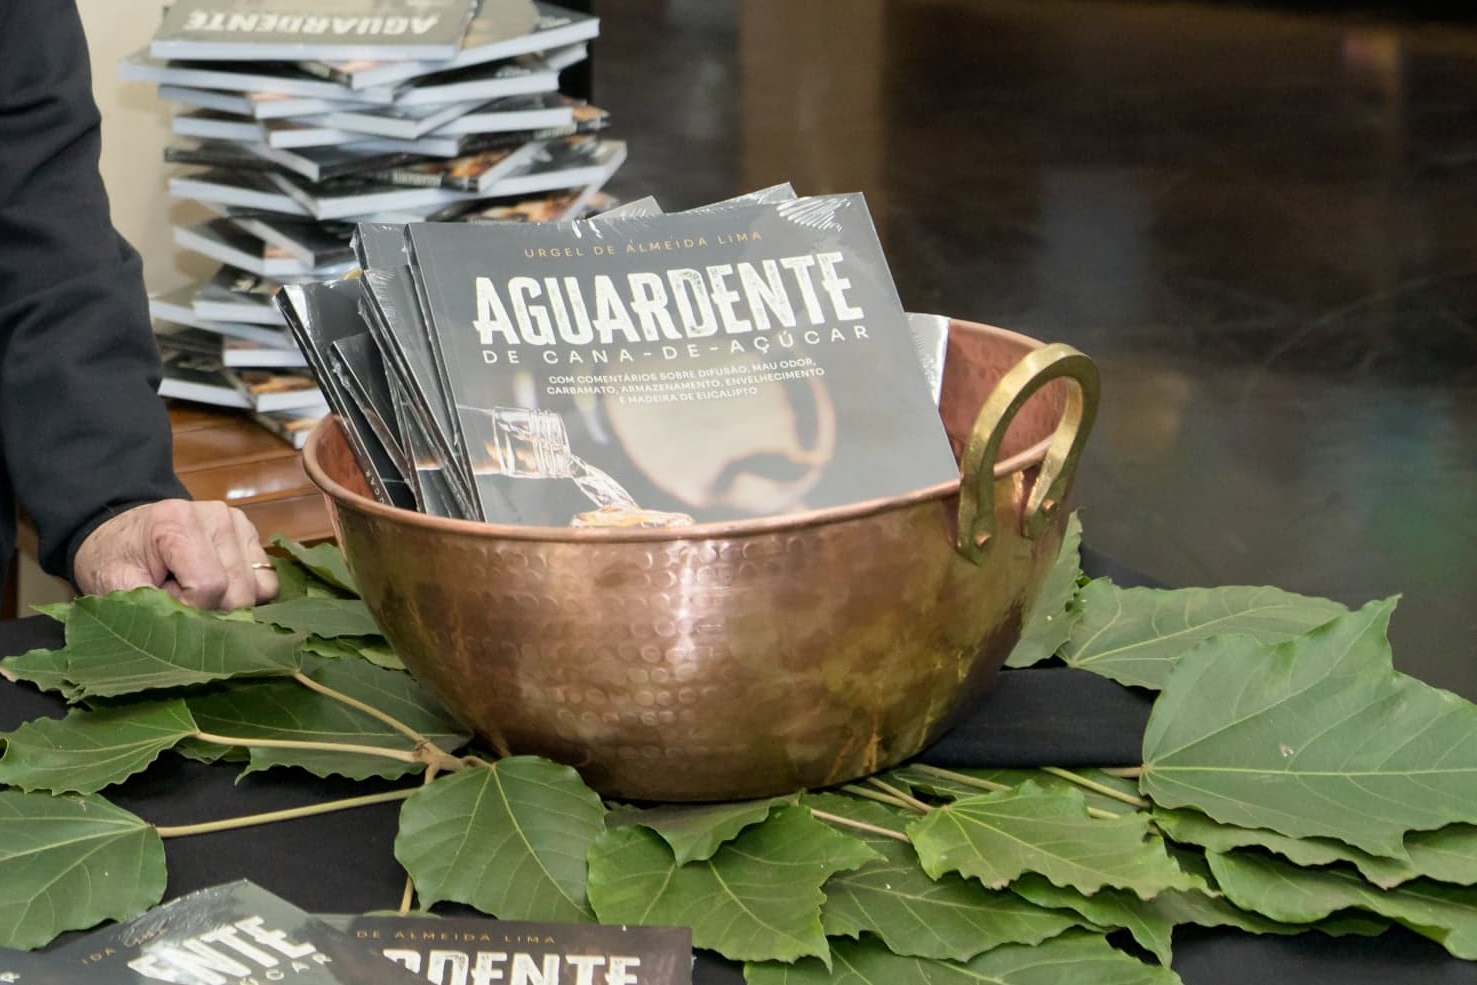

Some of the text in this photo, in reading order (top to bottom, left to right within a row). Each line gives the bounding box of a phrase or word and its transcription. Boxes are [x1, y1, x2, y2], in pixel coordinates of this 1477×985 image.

[184, 10, 439, 35] AGUARDENTE
[525, 231, 763, 259] URGEL DE ALMEIDA LIMA
[473, 252, 865, 347] AGUARDENTE
[482, 324, 870, 365] DE CANA-DE-AÇÚCAR
[546, 367, 825, 395] CARBAMATO, ARMAZENAMENTO, ENVELHECIMENTO
[548, 375, 575, 384] COM
[577, 370, 658, 384] COMENTÁRIOS
[659, 369, 696, 380] SOBRE
[751, 361, 778, 371] MAU
[779, 357, 817, 369] ODOR,
[628, 393, 679, 405] MADEIRA
[680, 391, 694, 401] DE
[696, 386, 758, 401] EUCALIPTO
[356, 929, 556, 944] DE ALMEIDA LIMA
